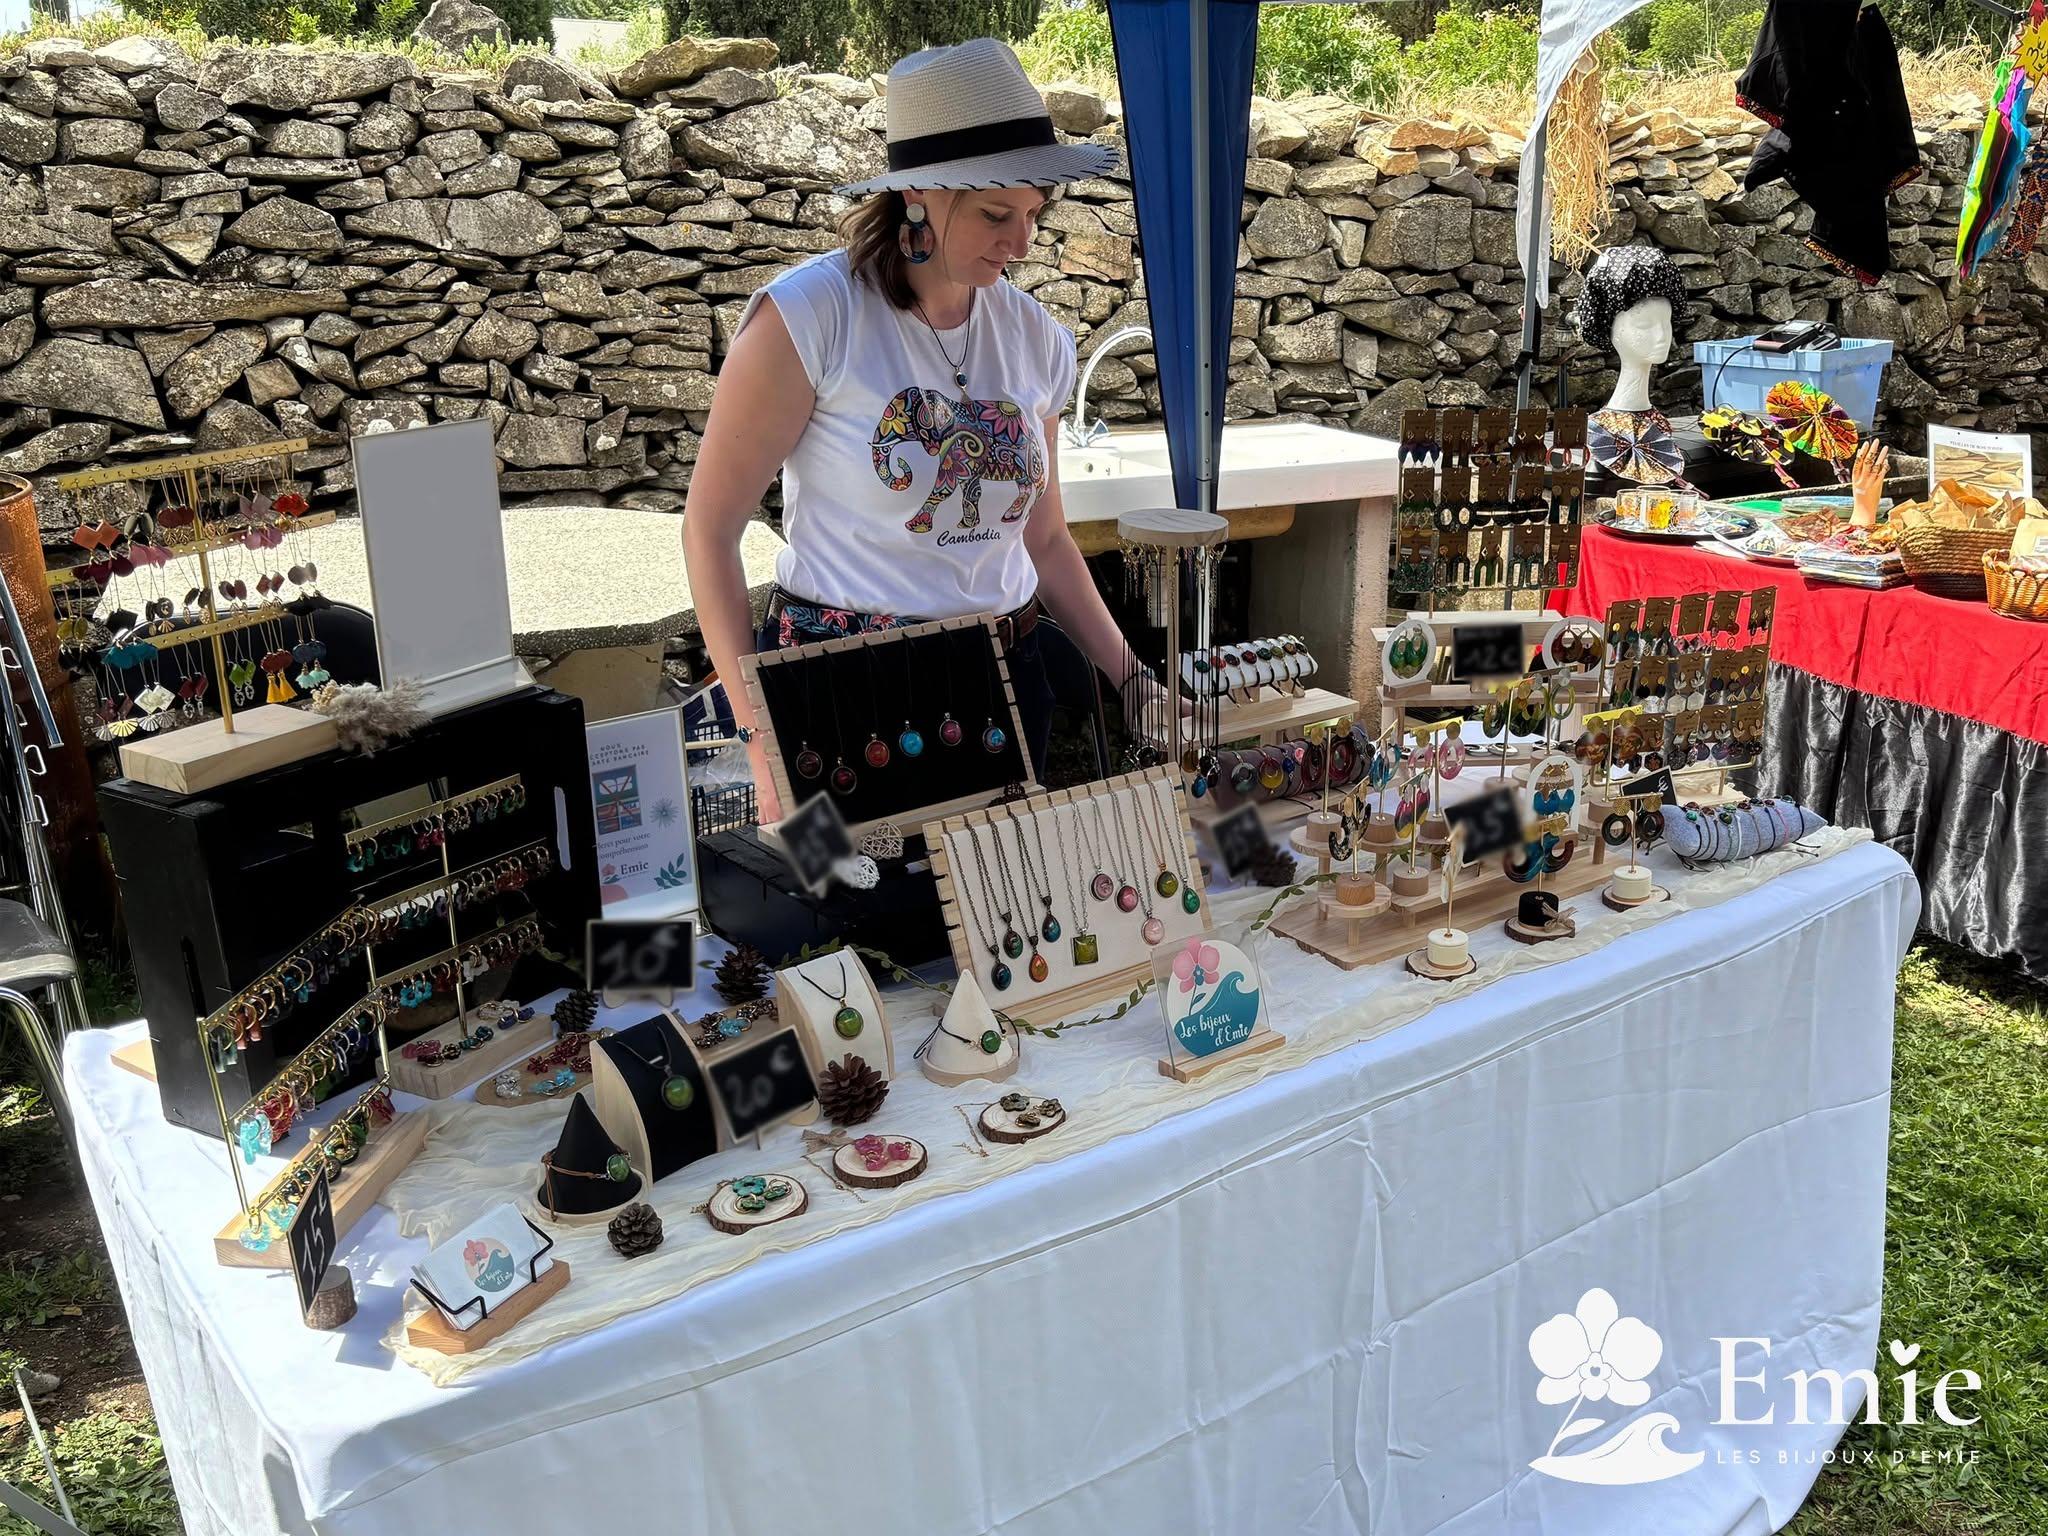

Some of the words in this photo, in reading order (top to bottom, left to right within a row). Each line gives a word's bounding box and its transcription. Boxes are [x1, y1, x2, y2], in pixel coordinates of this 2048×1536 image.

[936, 527, 1000, 547] Cambodia
[1180, 1021, 1198, 1039] Les
[1199, 1012, 1232, 1036] bijoux
[1214, 1023, 1250, 1047] d'Emie
